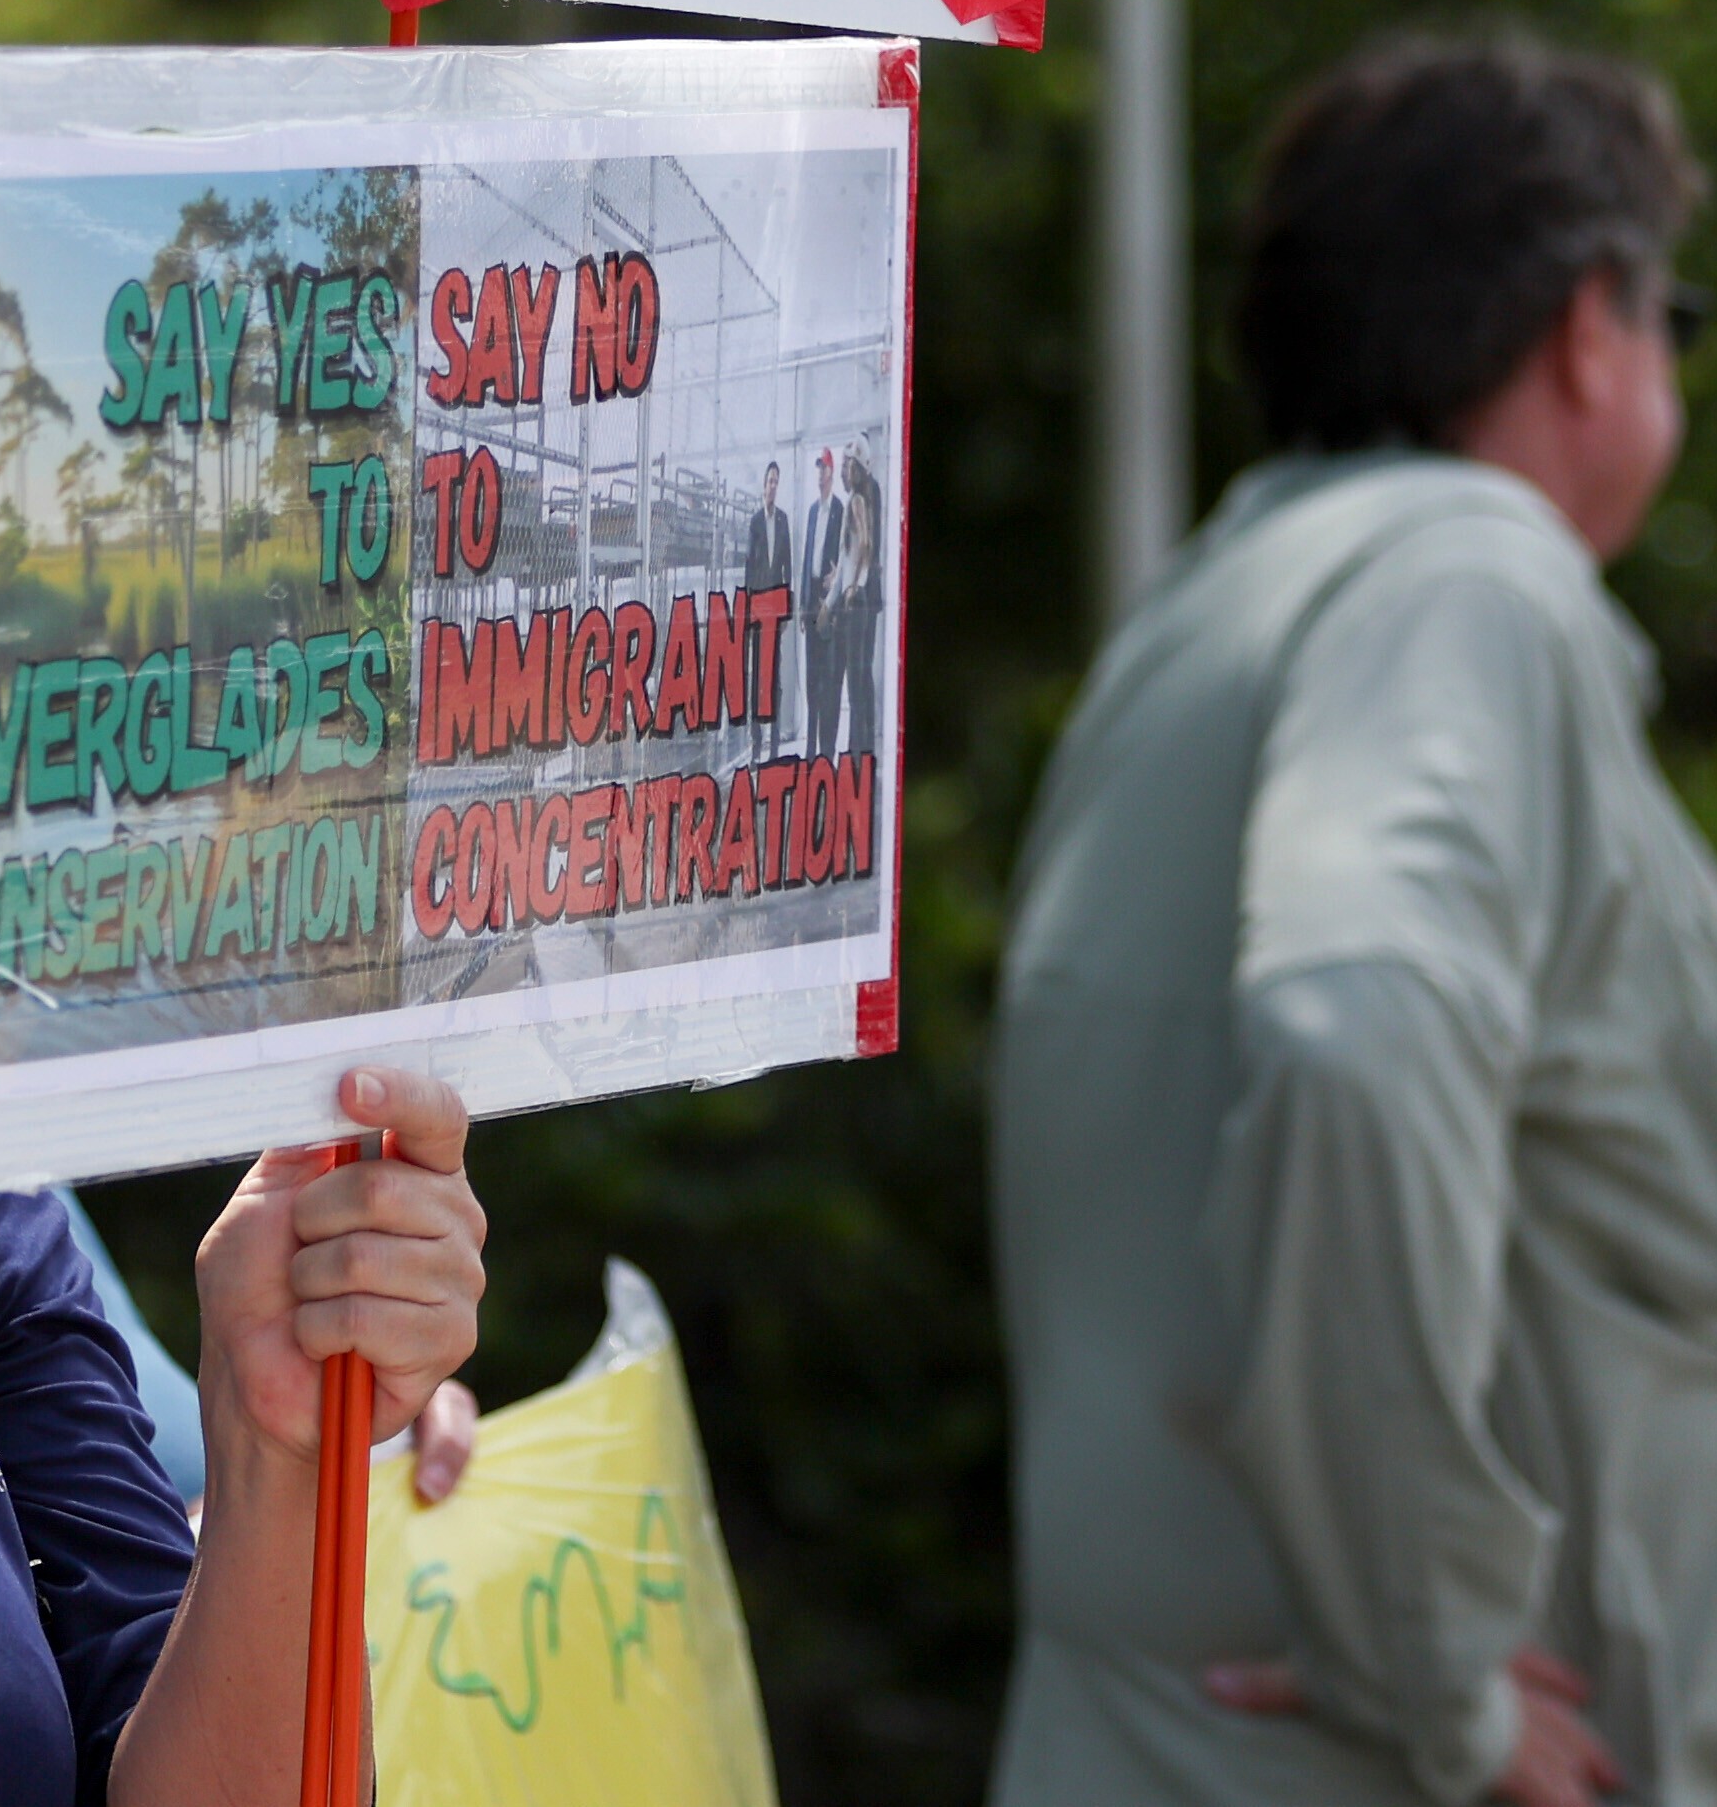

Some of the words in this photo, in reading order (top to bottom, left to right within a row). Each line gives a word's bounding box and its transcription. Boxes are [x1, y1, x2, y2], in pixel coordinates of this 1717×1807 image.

[99, 275, 250, 431] SAY
[265, 263, 401, 413] YES
[423, 261, 560, 409] SAY
[569, 249, 662, 404] NO
[309, 448, 392, 589] TO
[421, 444, 503, 578] TO
[416, 583, 792, 767] IMMIGRANT
[410, 751, 877, 942] CONCENTRATION
